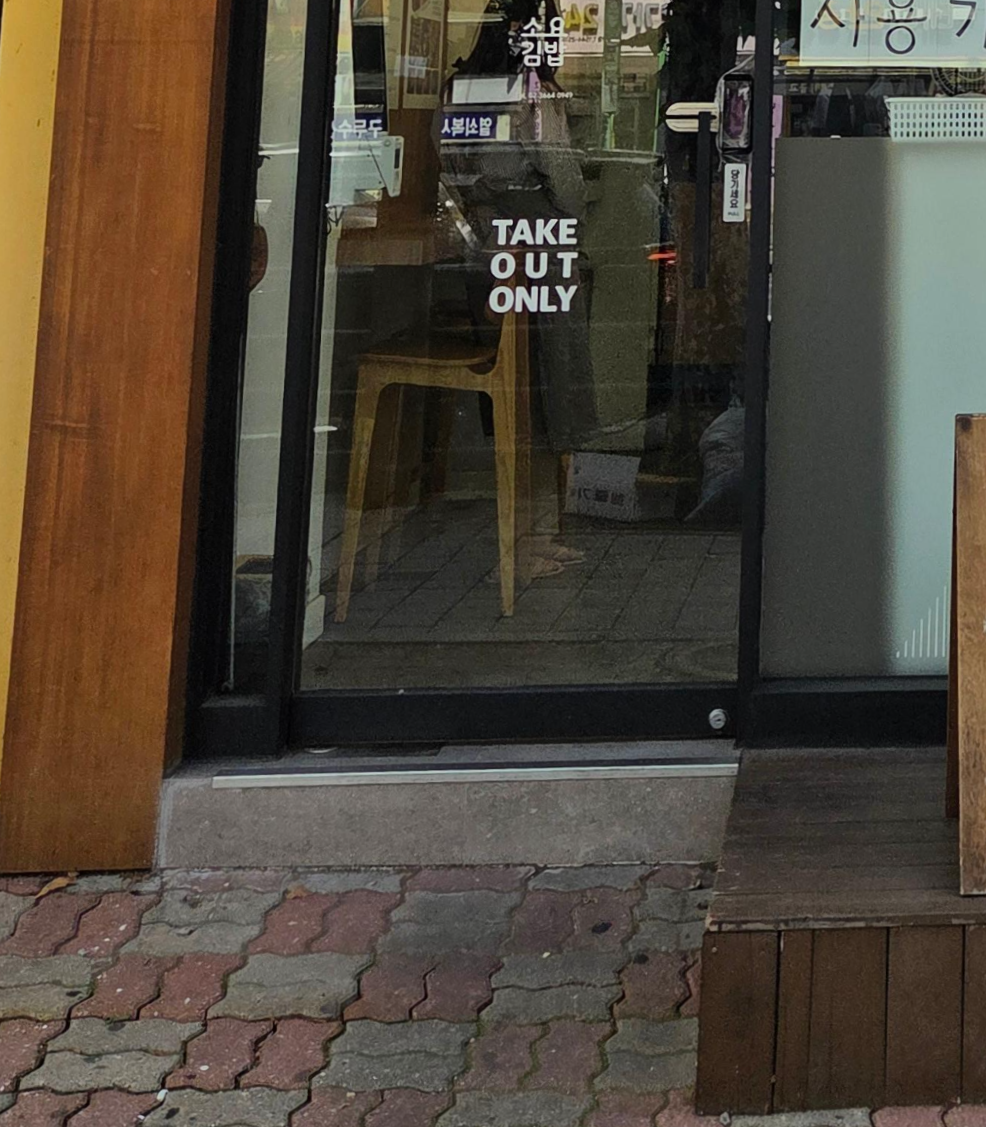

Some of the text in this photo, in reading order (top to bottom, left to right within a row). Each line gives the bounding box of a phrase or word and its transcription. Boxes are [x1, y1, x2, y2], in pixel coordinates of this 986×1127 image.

[521, 16, 568, 37] 소요
[522, 40, 566, 67] 김밥
[730, 169, 741, 209] 당기세요
[491, 218, 578, 245] TAKE
[490, 251, 579, 279] OUT
[489, 285, 578, 313] ONLY
